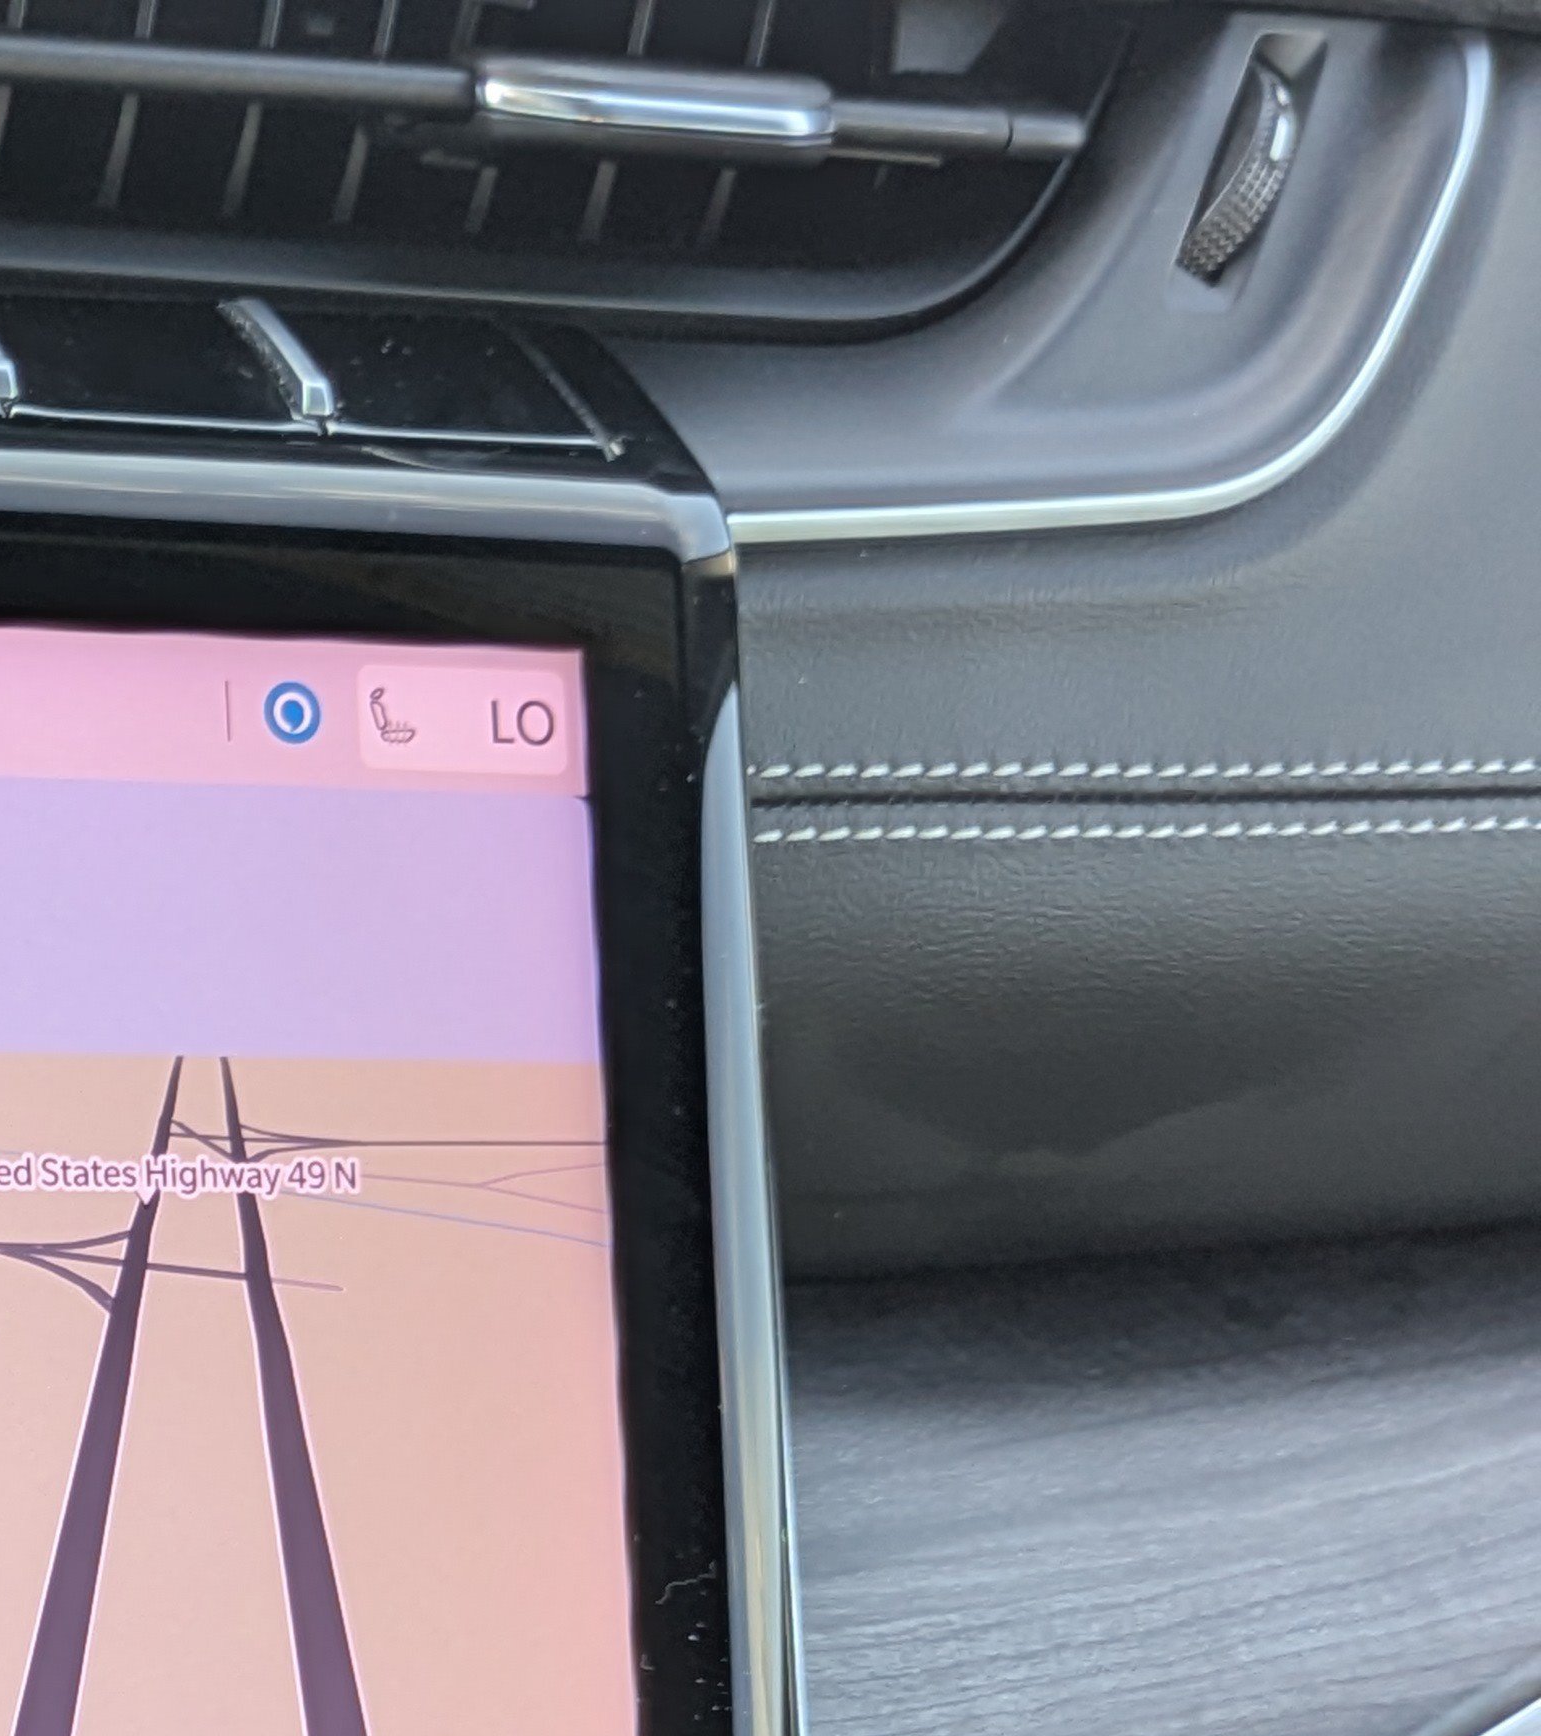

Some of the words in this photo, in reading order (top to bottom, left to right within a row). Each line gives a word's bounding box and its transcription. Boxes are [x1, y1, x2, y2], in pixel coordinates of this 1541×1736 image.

[491, 699, 556, 747] LO
[40, 1158, 137, 1188] States
[146, 1160, 282, 1196] Highway
[287, 1161, 325, 1190] 49
[331, 1162, 357, 1191] N
